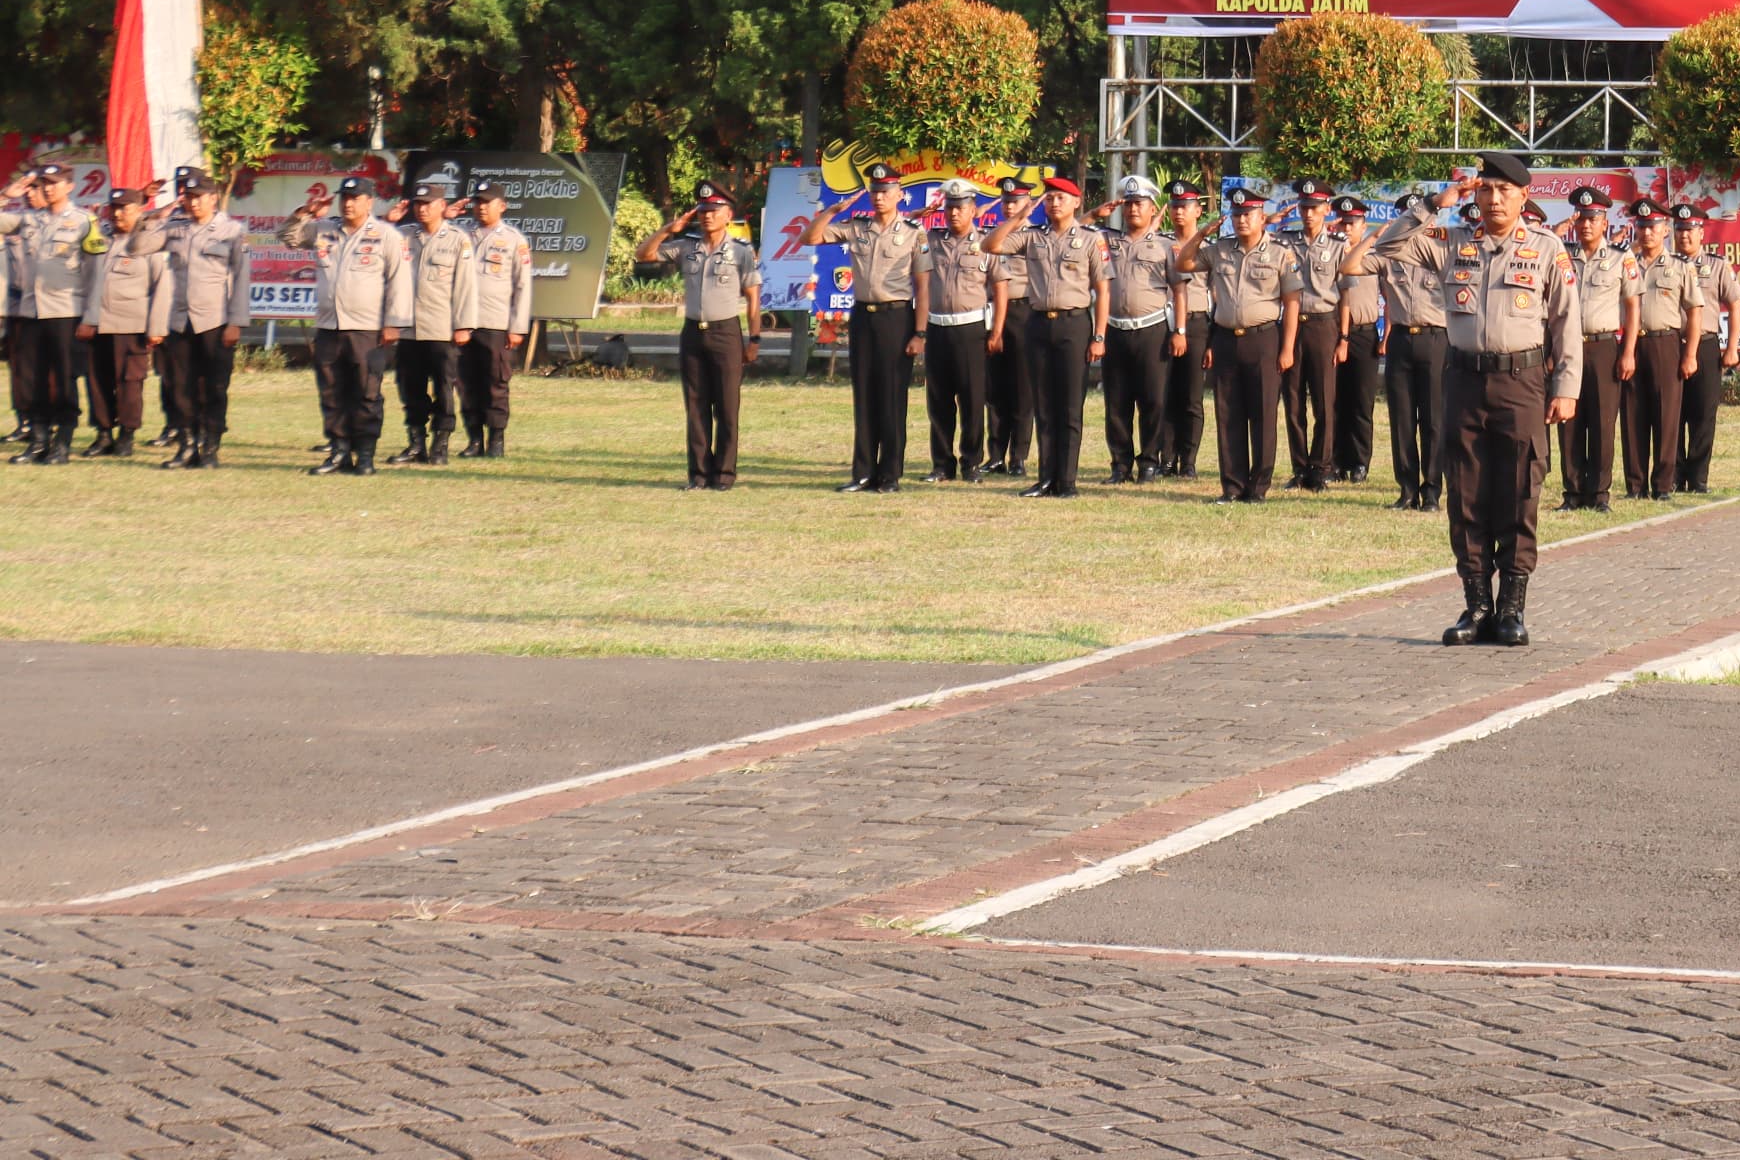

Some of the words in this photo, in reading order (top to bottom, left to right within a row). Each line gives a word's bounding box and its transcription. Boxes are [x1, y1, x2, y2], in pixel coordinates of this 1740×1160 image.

[470, 167, 505, 177] Segenap
[505, 167, 539, 177] keluarga
[524, 179, 579, 199] Pakdhe
[1560, 180, 1570, 195] &
[522, 218, 563, 234] HARI
[536, 236, 562, 252] KE
[563, 236, 587, 252] 79
[1510, 261, 1540, 270] POLRI
